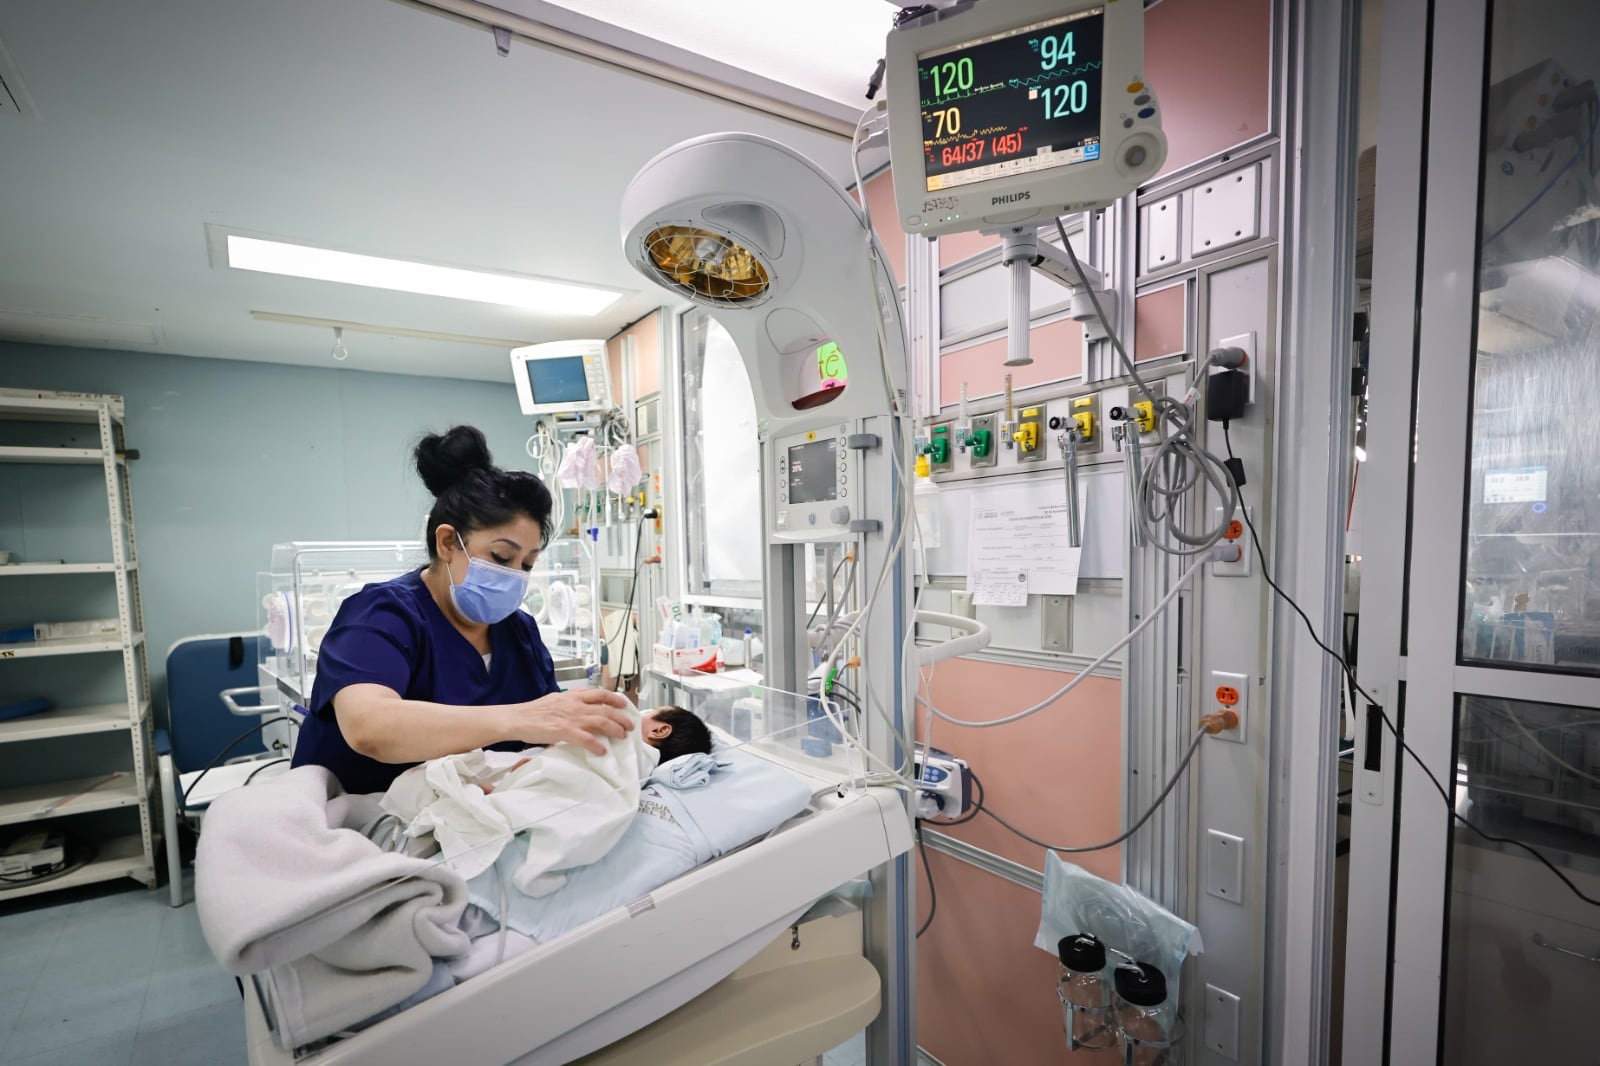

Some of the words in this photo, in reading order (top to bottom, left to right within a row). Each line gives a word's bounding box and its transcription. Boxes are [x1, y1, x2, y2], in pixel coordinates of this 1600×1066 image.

[1041, 31, 1076, 70] 94
[930, 57, 974, 97] 120
[1041, 80, 1087, 120] 120
[932, 107, 960, 138] 70
[942, 140, 985, 167] 64/37
[992, 132, 1022, 157] (45)
[991, 191, 1031, 206] PHILIPS
